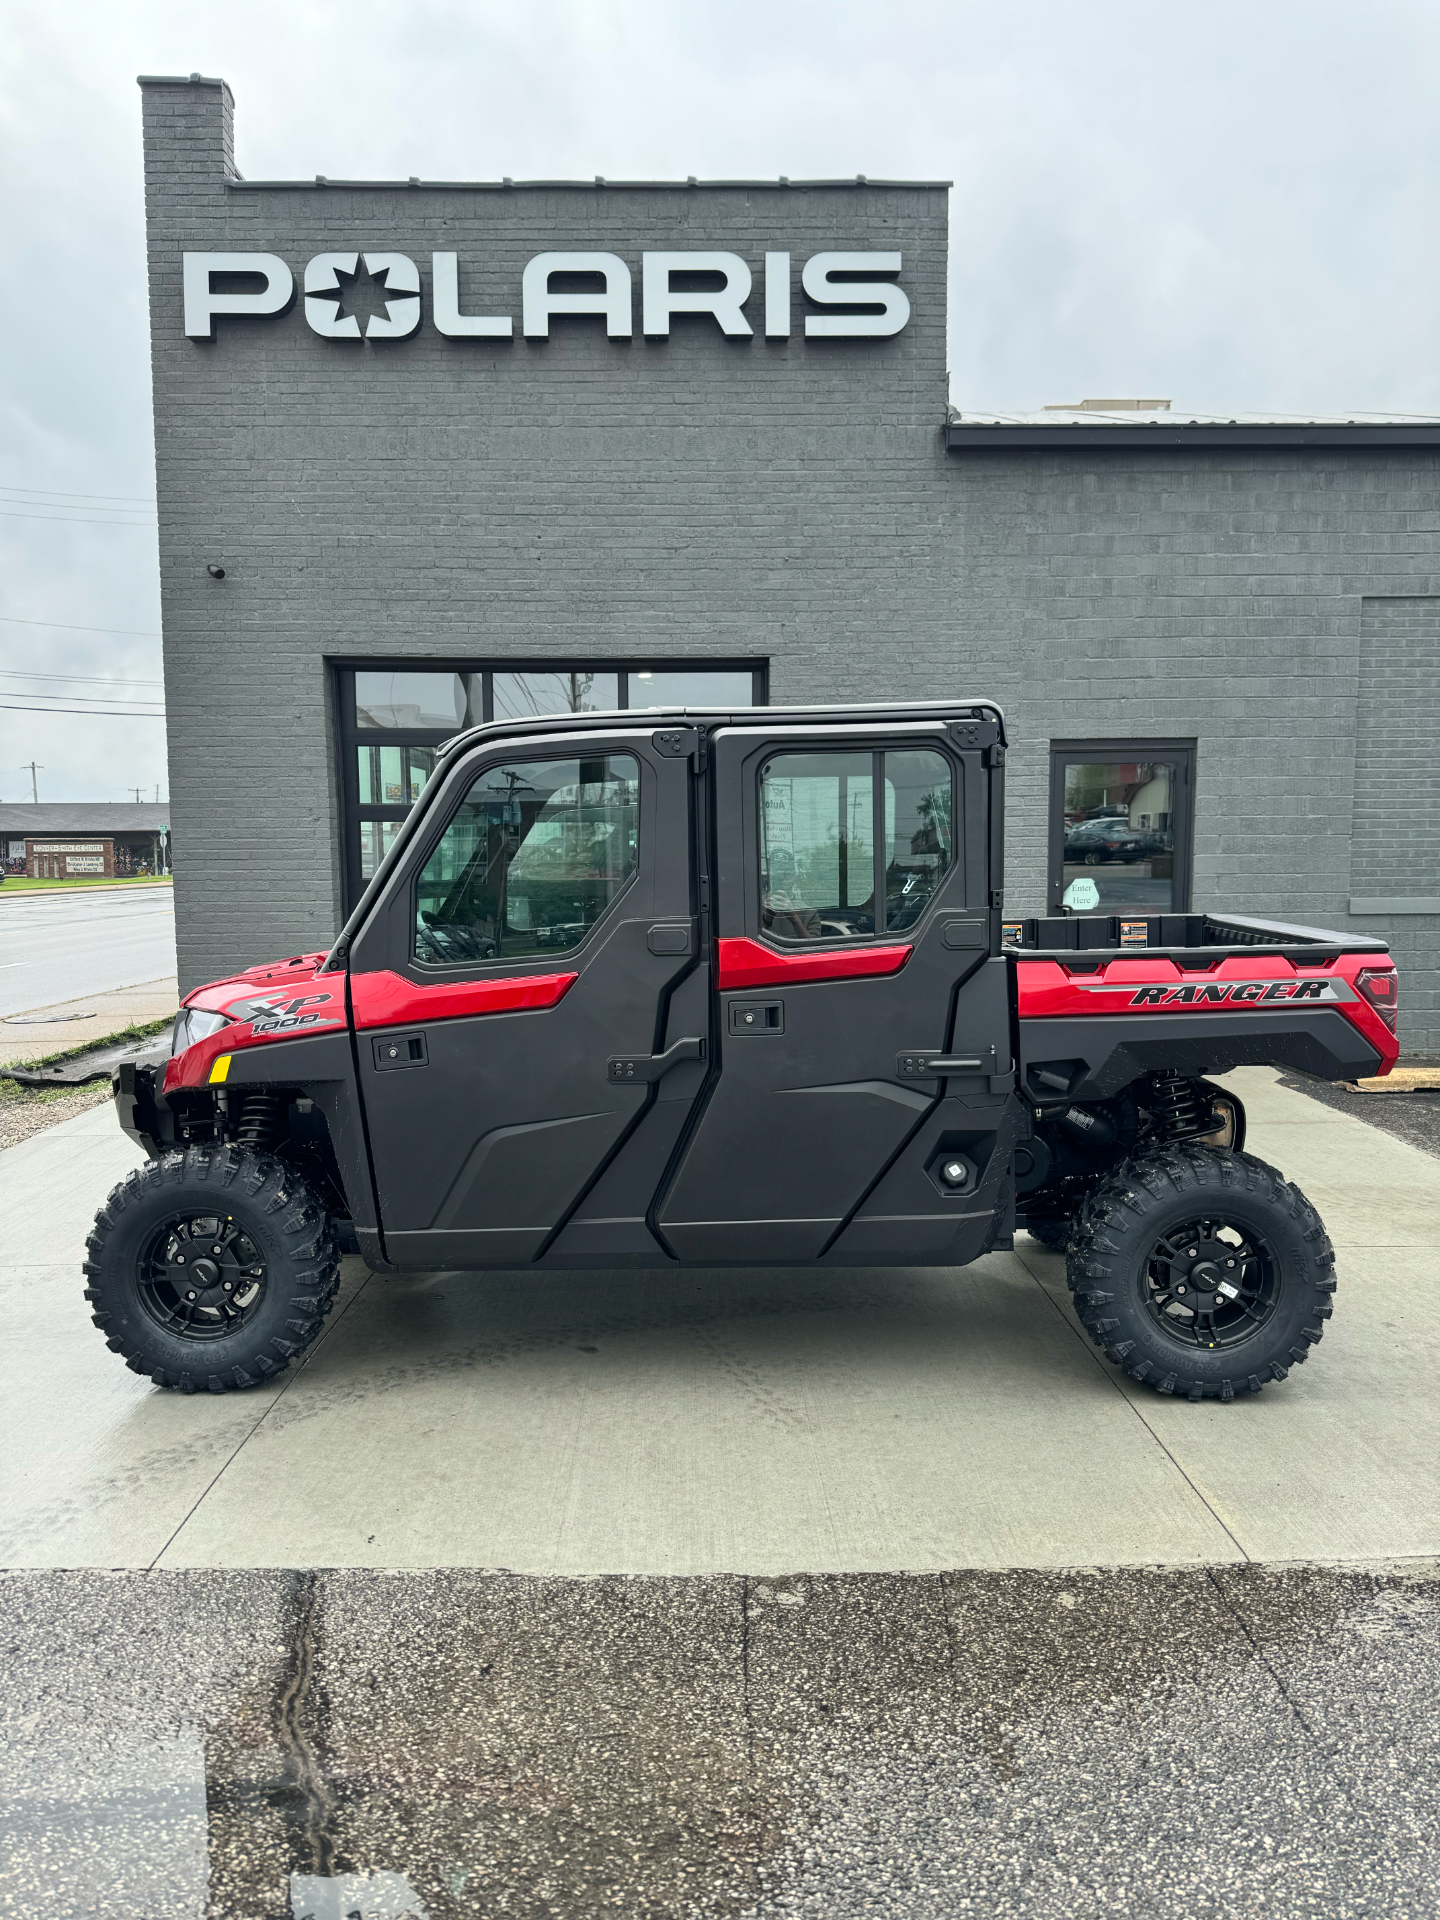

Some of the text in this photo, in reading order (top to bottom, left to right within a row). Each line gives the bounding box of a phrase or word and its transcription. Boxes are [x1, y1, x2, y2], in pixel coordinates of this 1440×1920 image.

[183, 250, 911, 339] POLARIS
[1072, 884, 1092, 892] Enter
[1073, 896, 1091, 904] Here
[1130, 981, 1330, 1005] RANGER
[236, 993, 333, 1026] XP
[251, 1013, 320, 1034] 1000
